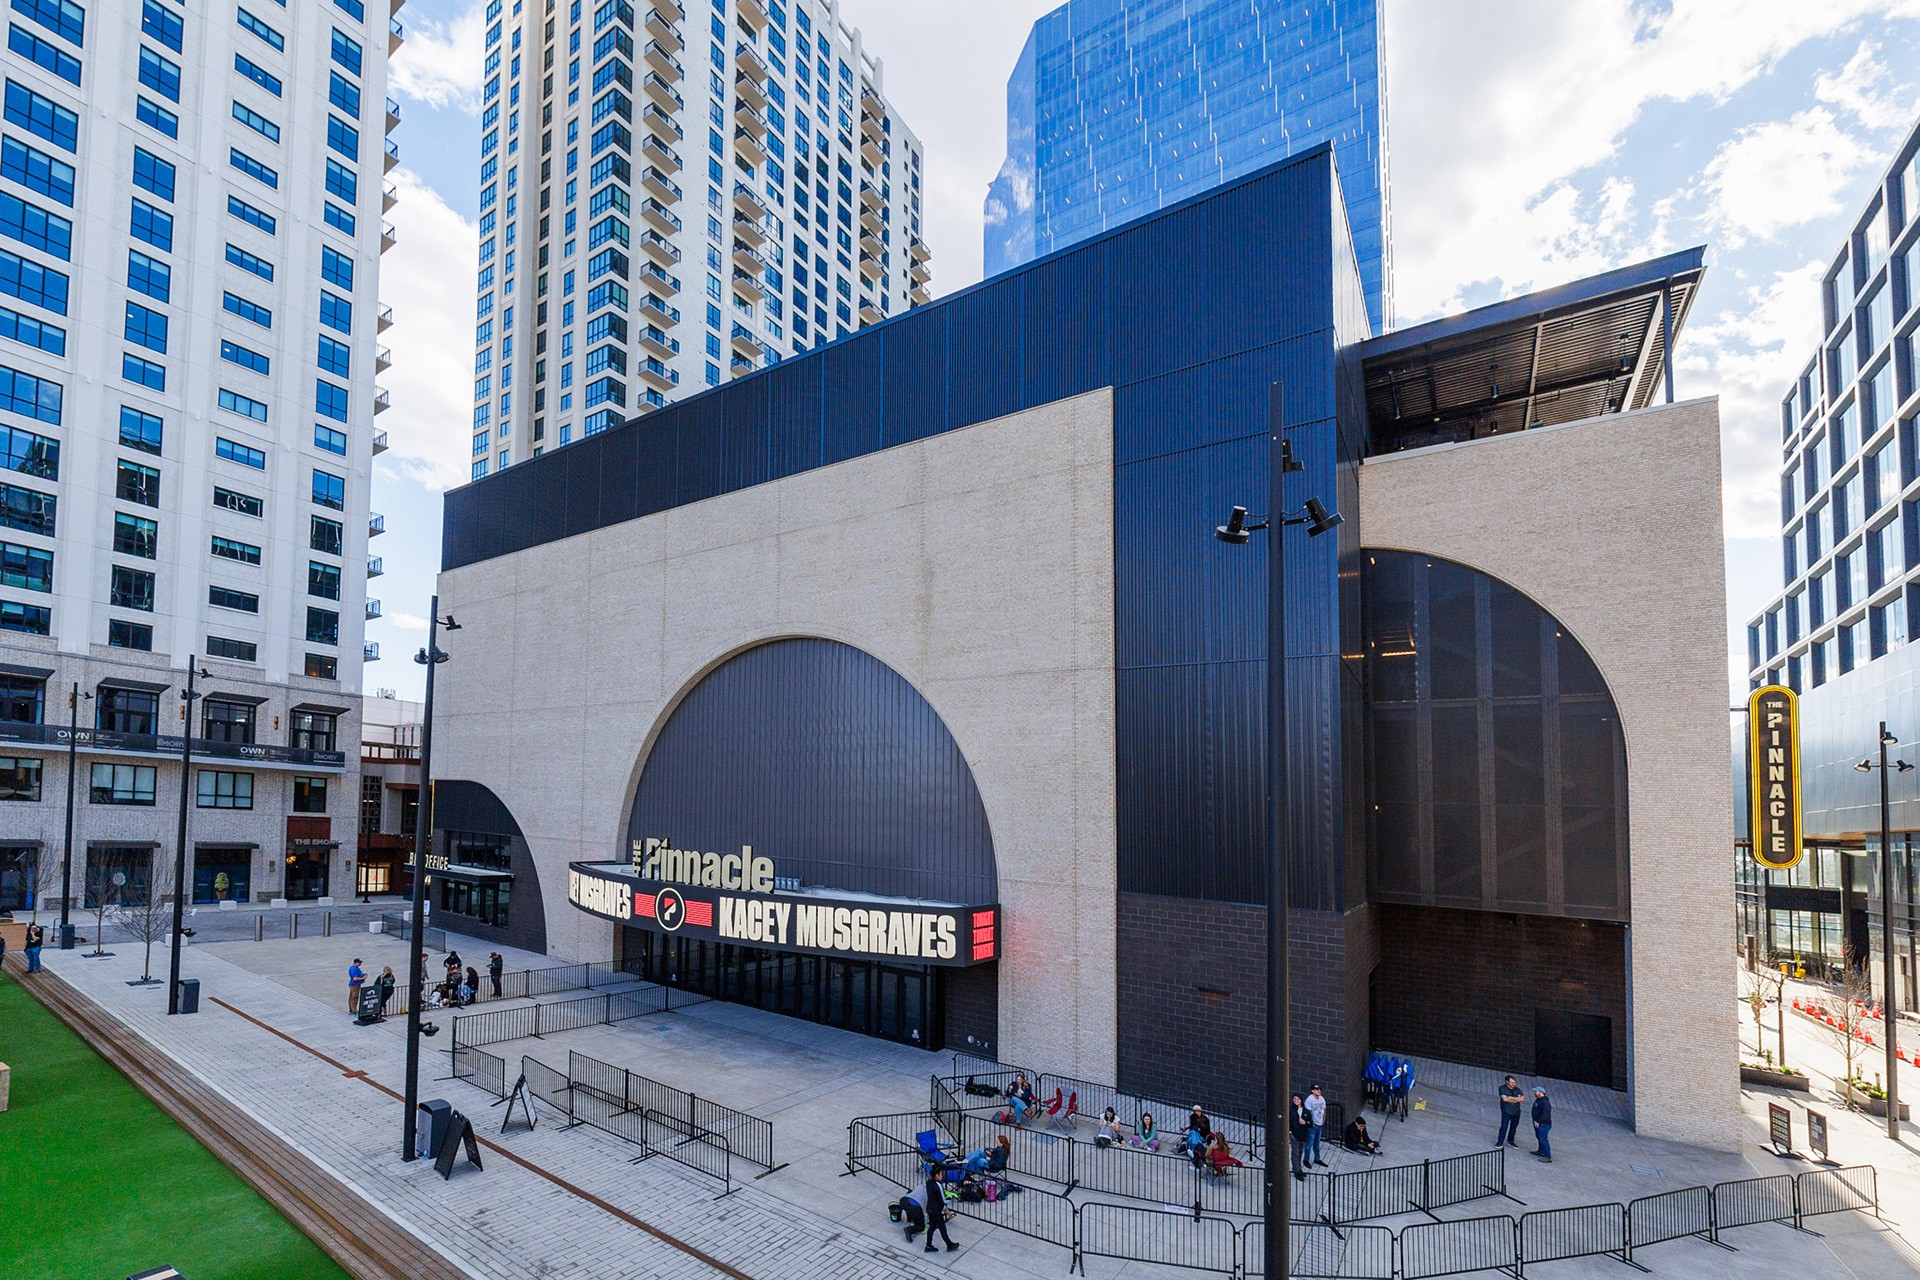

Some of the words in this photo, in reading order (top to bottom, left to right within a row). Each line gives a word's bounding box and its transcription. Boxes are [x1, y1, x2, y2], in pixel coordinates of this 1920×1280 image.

[57, 730, 90, 740] OWN
[240, 746, 265, 755] OWN
[1767, 713, 1786, 853] PINNACLE
[312, 838, 339, 846] EMORY
[632, 839, 642, 874] THE
[646, 836, 774, 893] Pinnacle
[579, 873, 631, 920] MUSGRAVES
[718, 896, 791, 944] KACEY
[796, 904, 957, 960] MUSGRAVES
